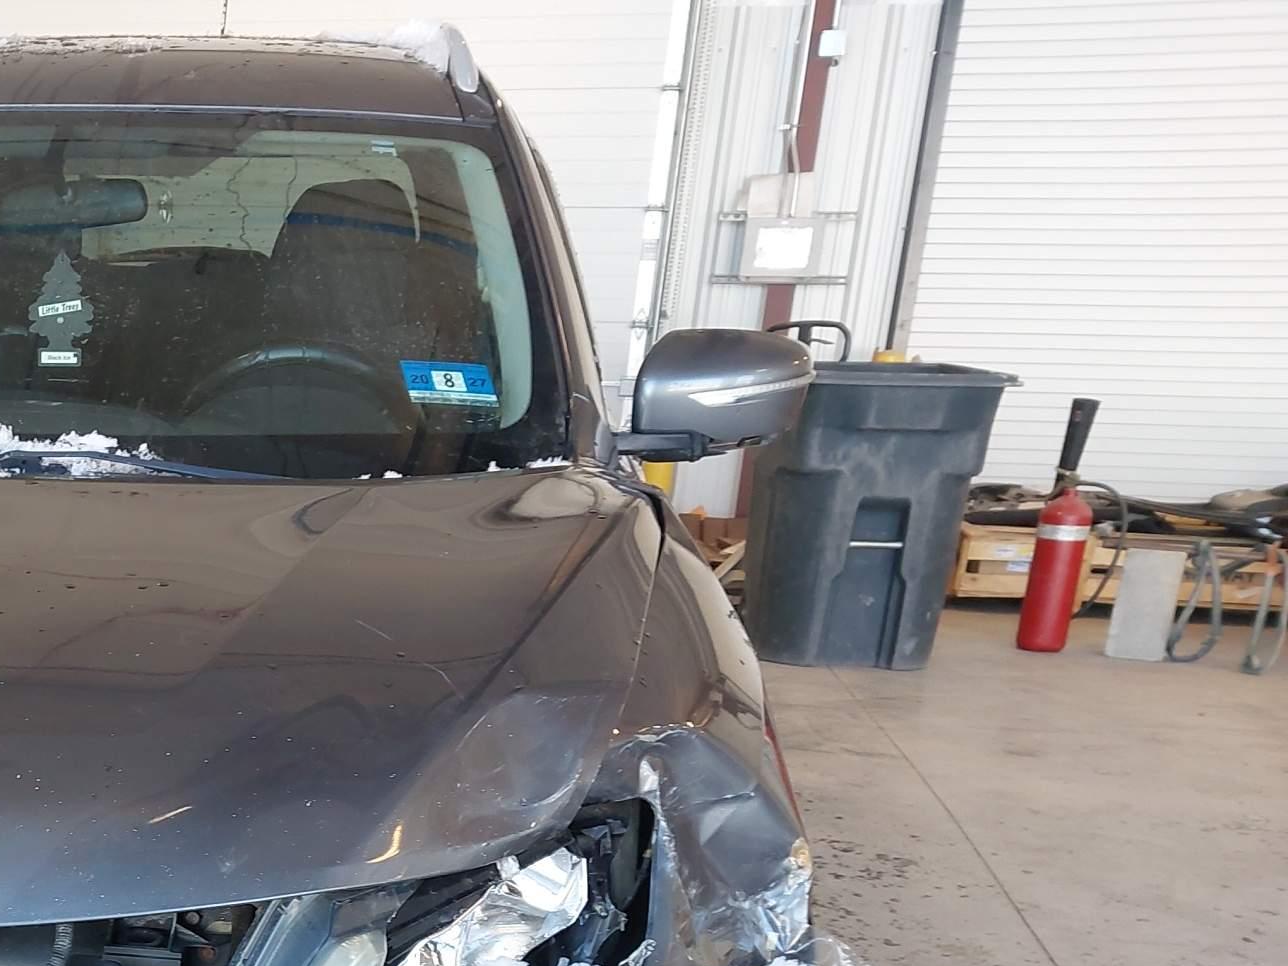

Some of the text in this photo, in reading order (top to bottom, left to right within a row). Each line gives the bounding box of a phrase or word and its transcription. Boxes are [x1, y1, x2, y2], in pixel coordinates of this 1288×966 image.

[41, 302, 79, 315] Little Trees
[410, 373, 487, 388] 20 8 27
